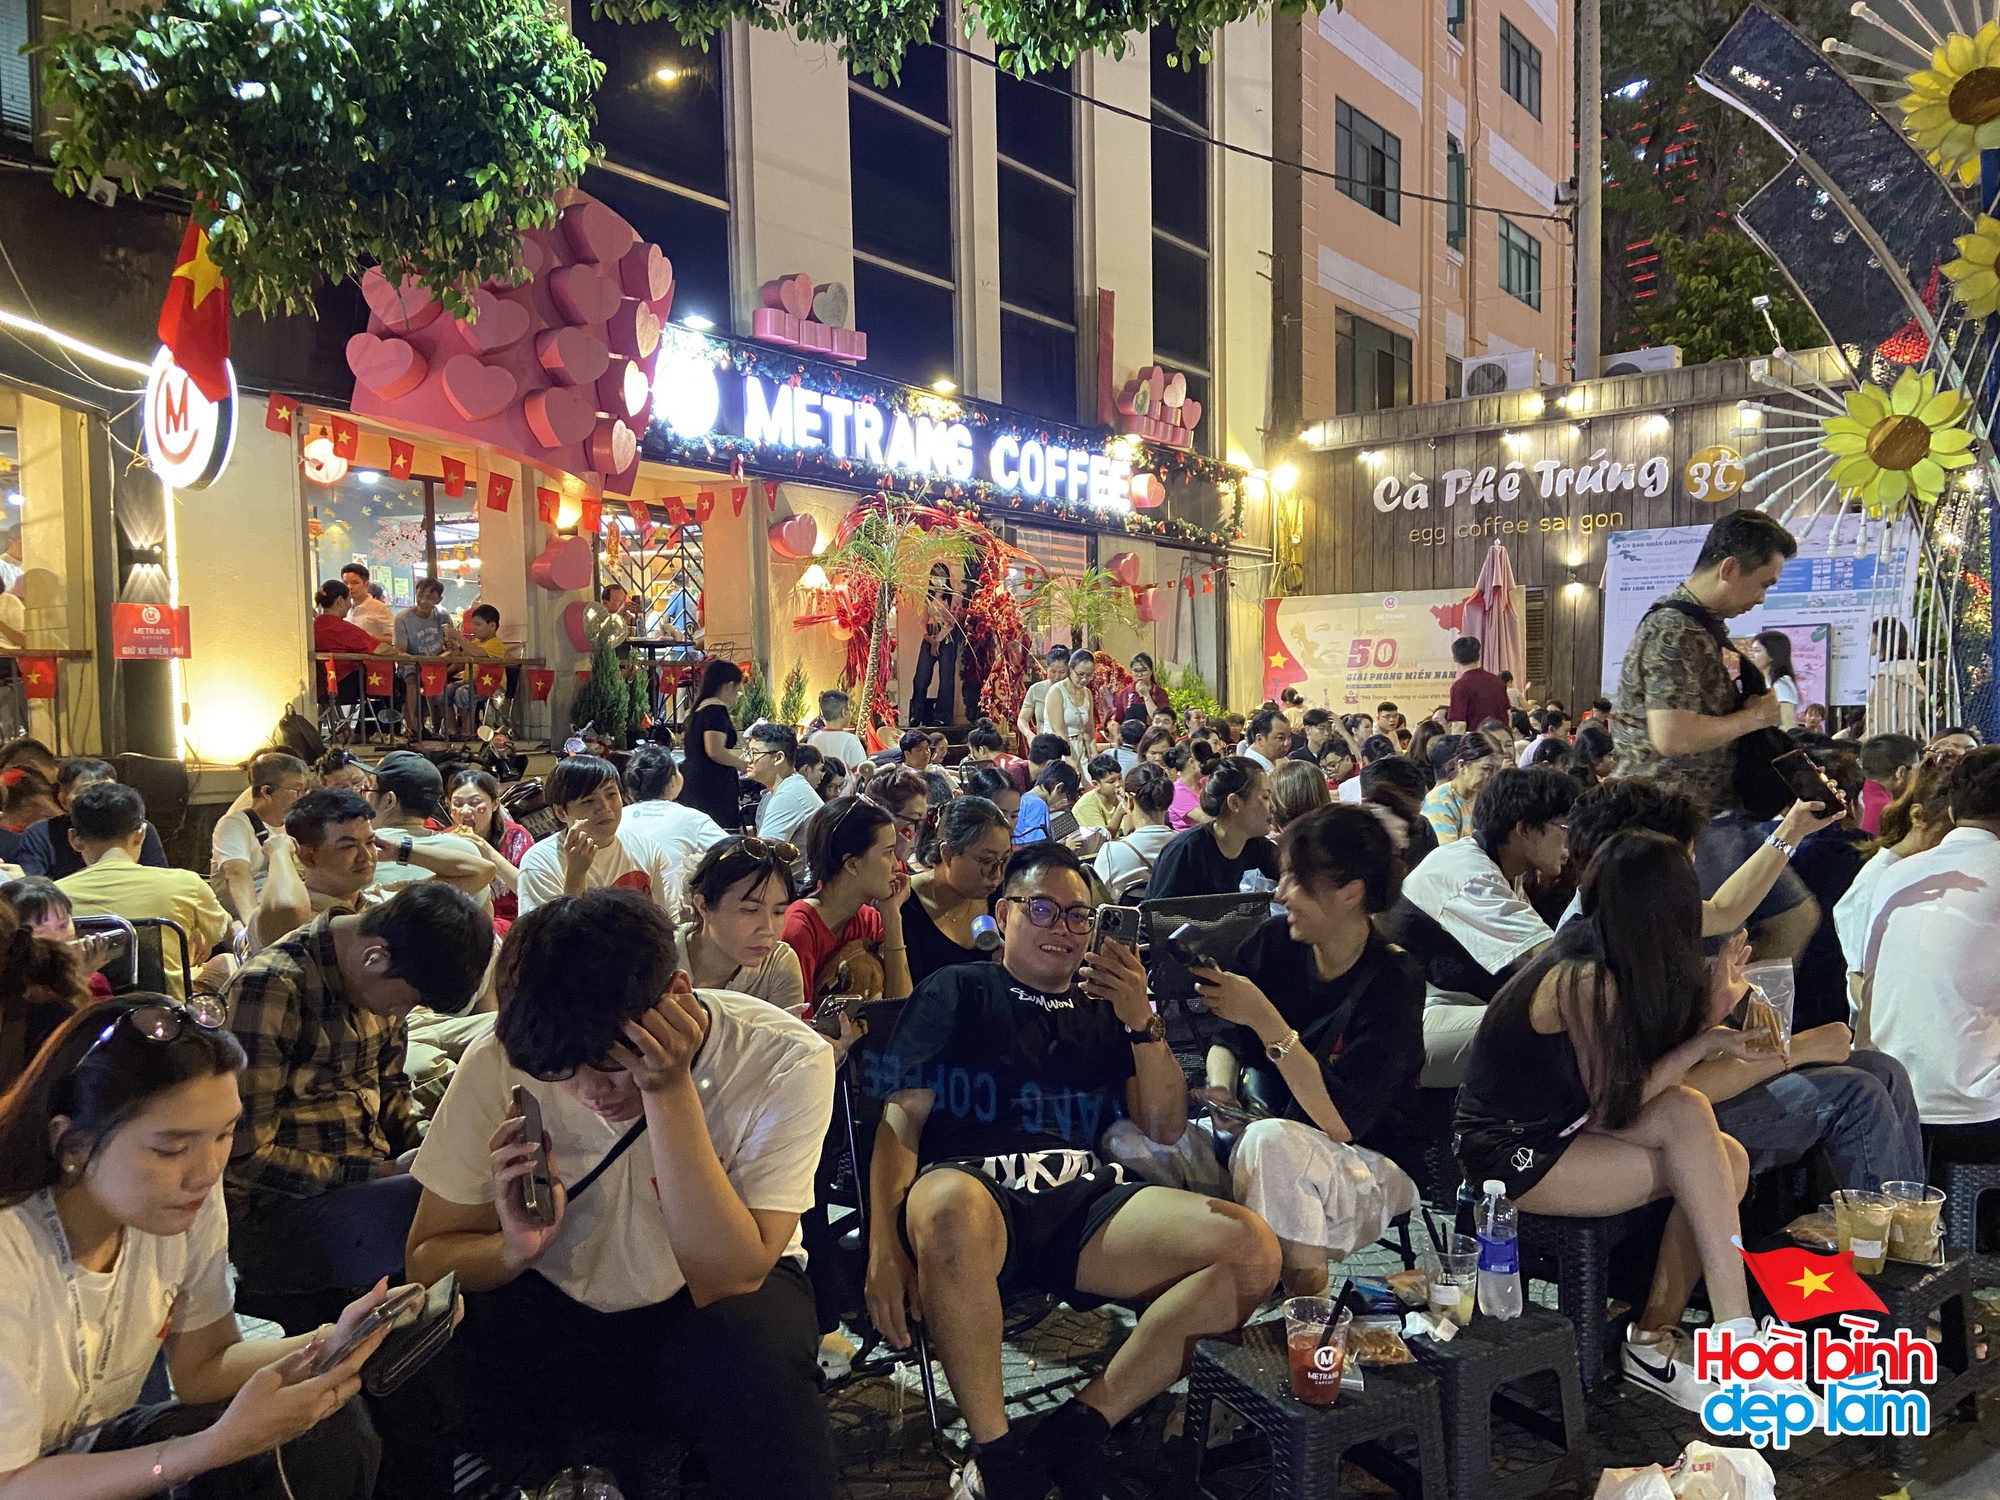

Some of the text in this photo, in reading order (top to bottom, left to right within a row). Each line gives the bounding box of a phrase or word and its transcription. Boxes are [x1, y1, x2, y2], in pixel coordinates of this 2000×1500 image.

[744, 375, 1131, 514] METRANG COFFEE
[1373, 471, 1429, 513] Cà
[1442, 461, 1522, 508] Phê
[1534, 448, 1669, 498] Trứng
[1409, 509, 1624, 547] egg coffee sai gon
[133, 627, 171, 635] METRANG
[137, 646, 147, 655] XE
[1346, 638, 1398, 668] 50
[1433, 670, 1458, 679] NAM
[1308, 1371, 1339, 1380] METRANG
